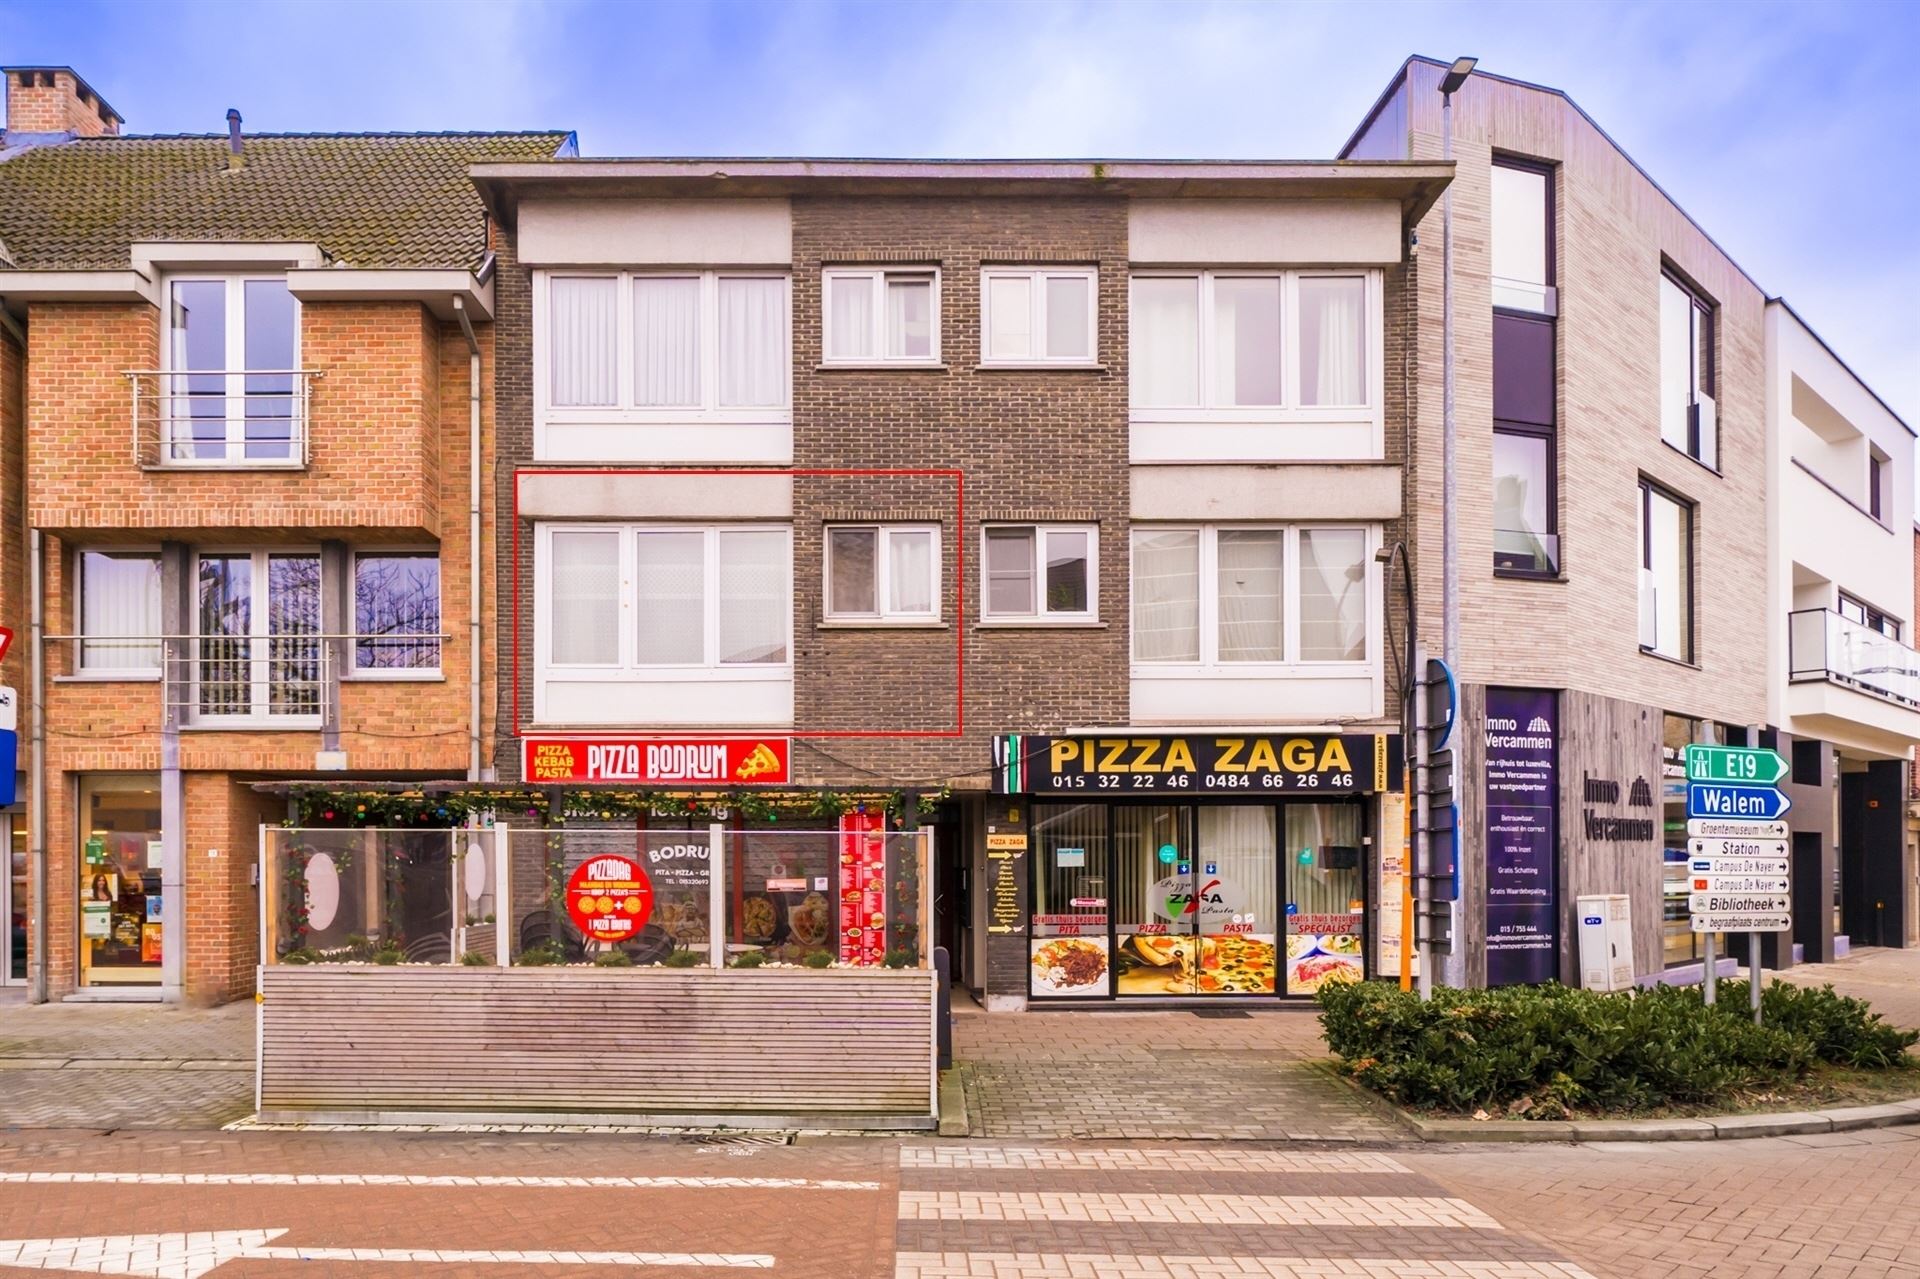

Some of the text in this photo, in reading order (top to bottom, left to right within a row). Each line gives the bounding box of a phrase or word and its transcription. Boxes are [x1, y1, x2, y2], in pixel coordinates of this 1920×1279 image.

[1485, 715, 1517, 731] Immo
[1485, 732, 1552, 749] Vercammen
[537, 745, 571, 756] PIZZA
[1051, 738, 1352, 773] PIZZA ZAGA
[534, 756, 575, 767] KEBAB
[587, 744, 727, 779] PIZZA BODRUM
[1726, 753, 1757, 778] E19
[536, 767, 573, 778] PASTA
[1506, 771, 1541, 779] Vercammen
[1541, 772, 1548, 780] is
[1053, 774, 1353, 788] 015 32 22 46 0484 66 26 46
[1499, 783, 1547, 792] vastgoedpartner
[1584, 770, 1620, 805] Immo
[1703, 789, 1765, 814] Walem
[1584, 808, 1654, 842] Vercammen
[1701, 822, 1760, 835] Groentemuseum
[648, 844, 710, 864] BODRU
[1722, 841, 1760, 855] Station
[1714, 860, 1742, 875] Campus
[1744, 860, 1753, 872] De
[1755, 861, 1775, 875] Nayer
[1160, 880, 1191, 893] Pizza
[1714, 878, 1742, 893] Campus
[1744, 878, 1753, 891] De
[1755, 879, 1775, 893] Nayer
[1169, 894, 1223, 904] ZAGA
[1709, 898, 1774, 911] Bibliotheek
[1201, 906, 1234, 914] Pasta
[1033, 914, 1106, 924] Gratis thuis bezorgen
[1289, 914, 1360, 924] Gratis thuis bezorgen
[1709, 916, 1780, 930] begraafplaats centrum
[1059, 925, 1080, 934] PITA
[1139, 925, 1167, 933] PIZZA
[1223, 924, 1254, 933] PASTA
[1298, 924, 1352, 934] SPECIALIST
[1486, 934, 1552, 942] nfo@immovercammen.be
